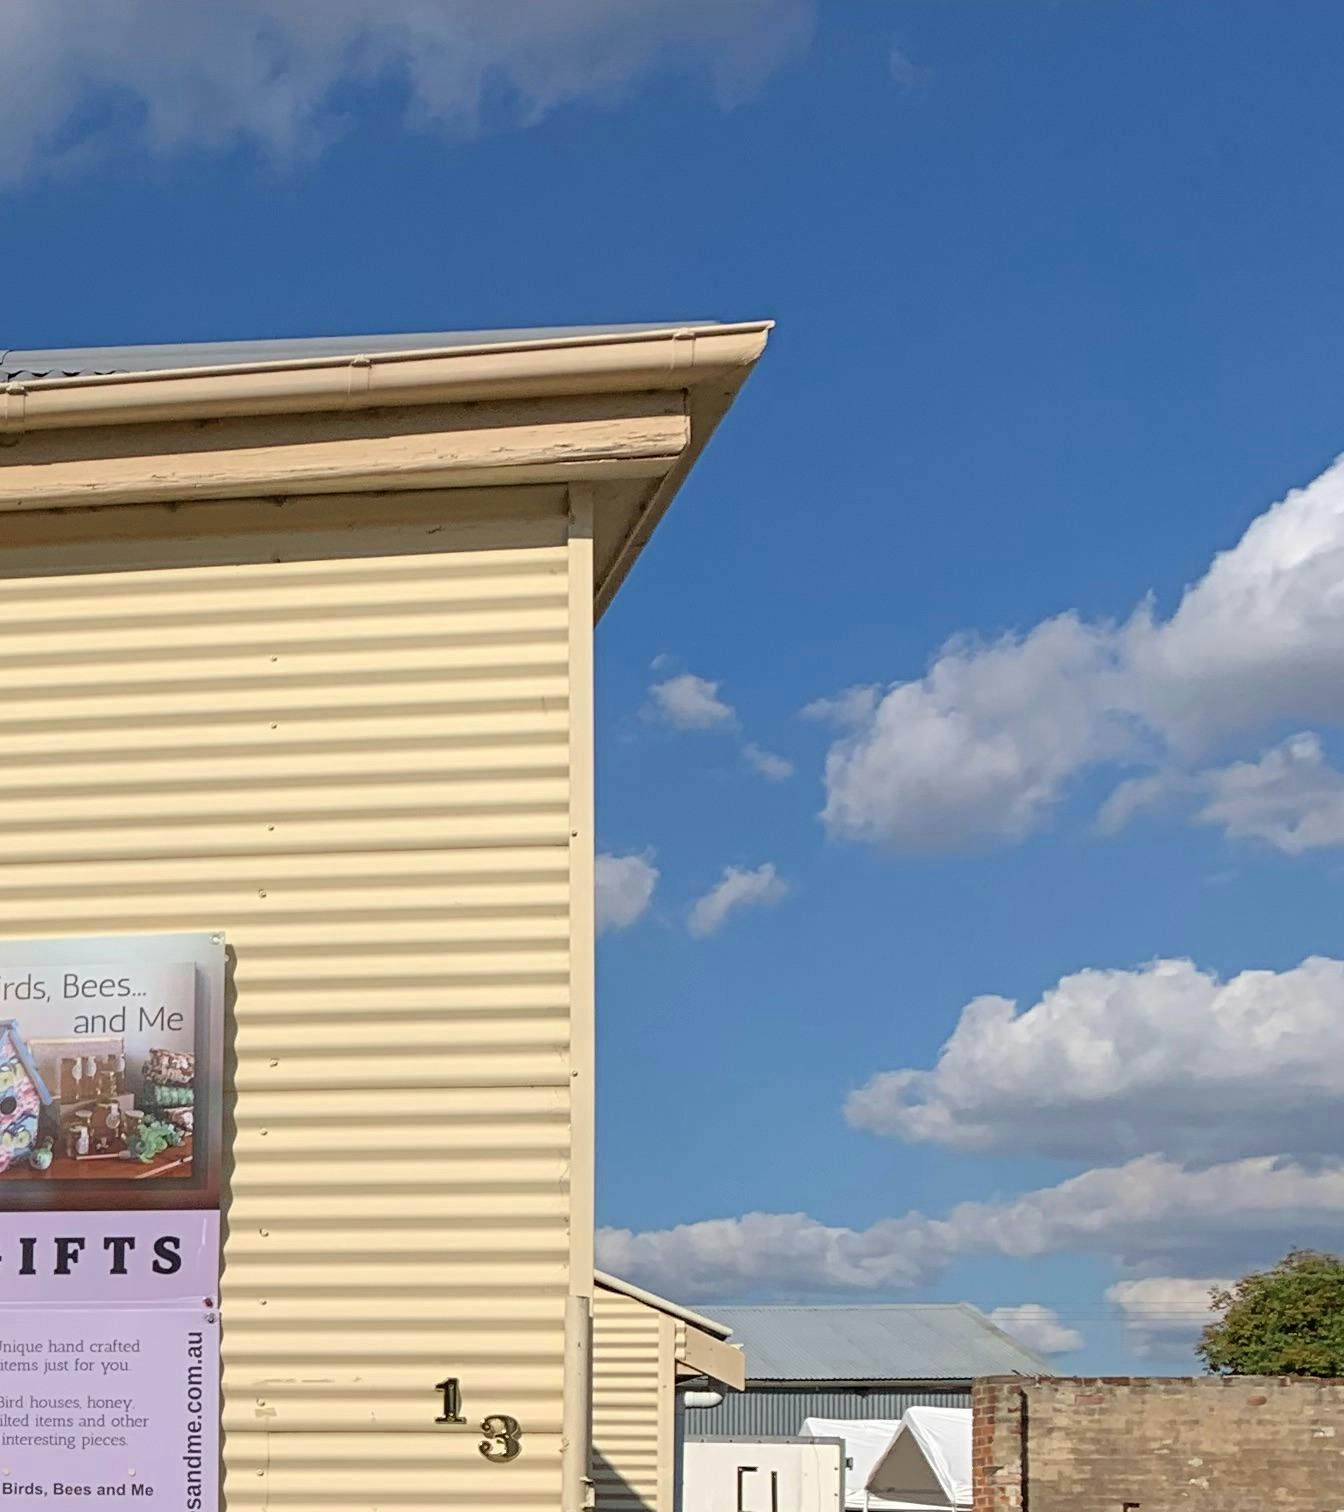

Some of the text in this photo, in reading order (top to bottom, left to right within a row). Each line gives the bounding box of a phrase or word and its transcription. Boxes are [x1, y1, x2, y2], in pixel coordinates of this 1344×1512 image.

[73, 1006, 184, 1034] and Me
[48, 1340, 84, 1353] hand
[89, 1340, 141, 1353] crafted
[0, 1359, 39, 1372] items
[43, 1359, 69, 1374] just
[74, 1358, 95, 1372] for
[30, 1395, 82, 1410] houses,
[35, 1414, 74, 1427] items
[78, 1415, 105, 1428] and
[110, 1414, 150, 1428] other
[1, 1433, 129, 1450] interesting pieces.
[2, 1482, 154, 1497] Birds, Bees and Me
